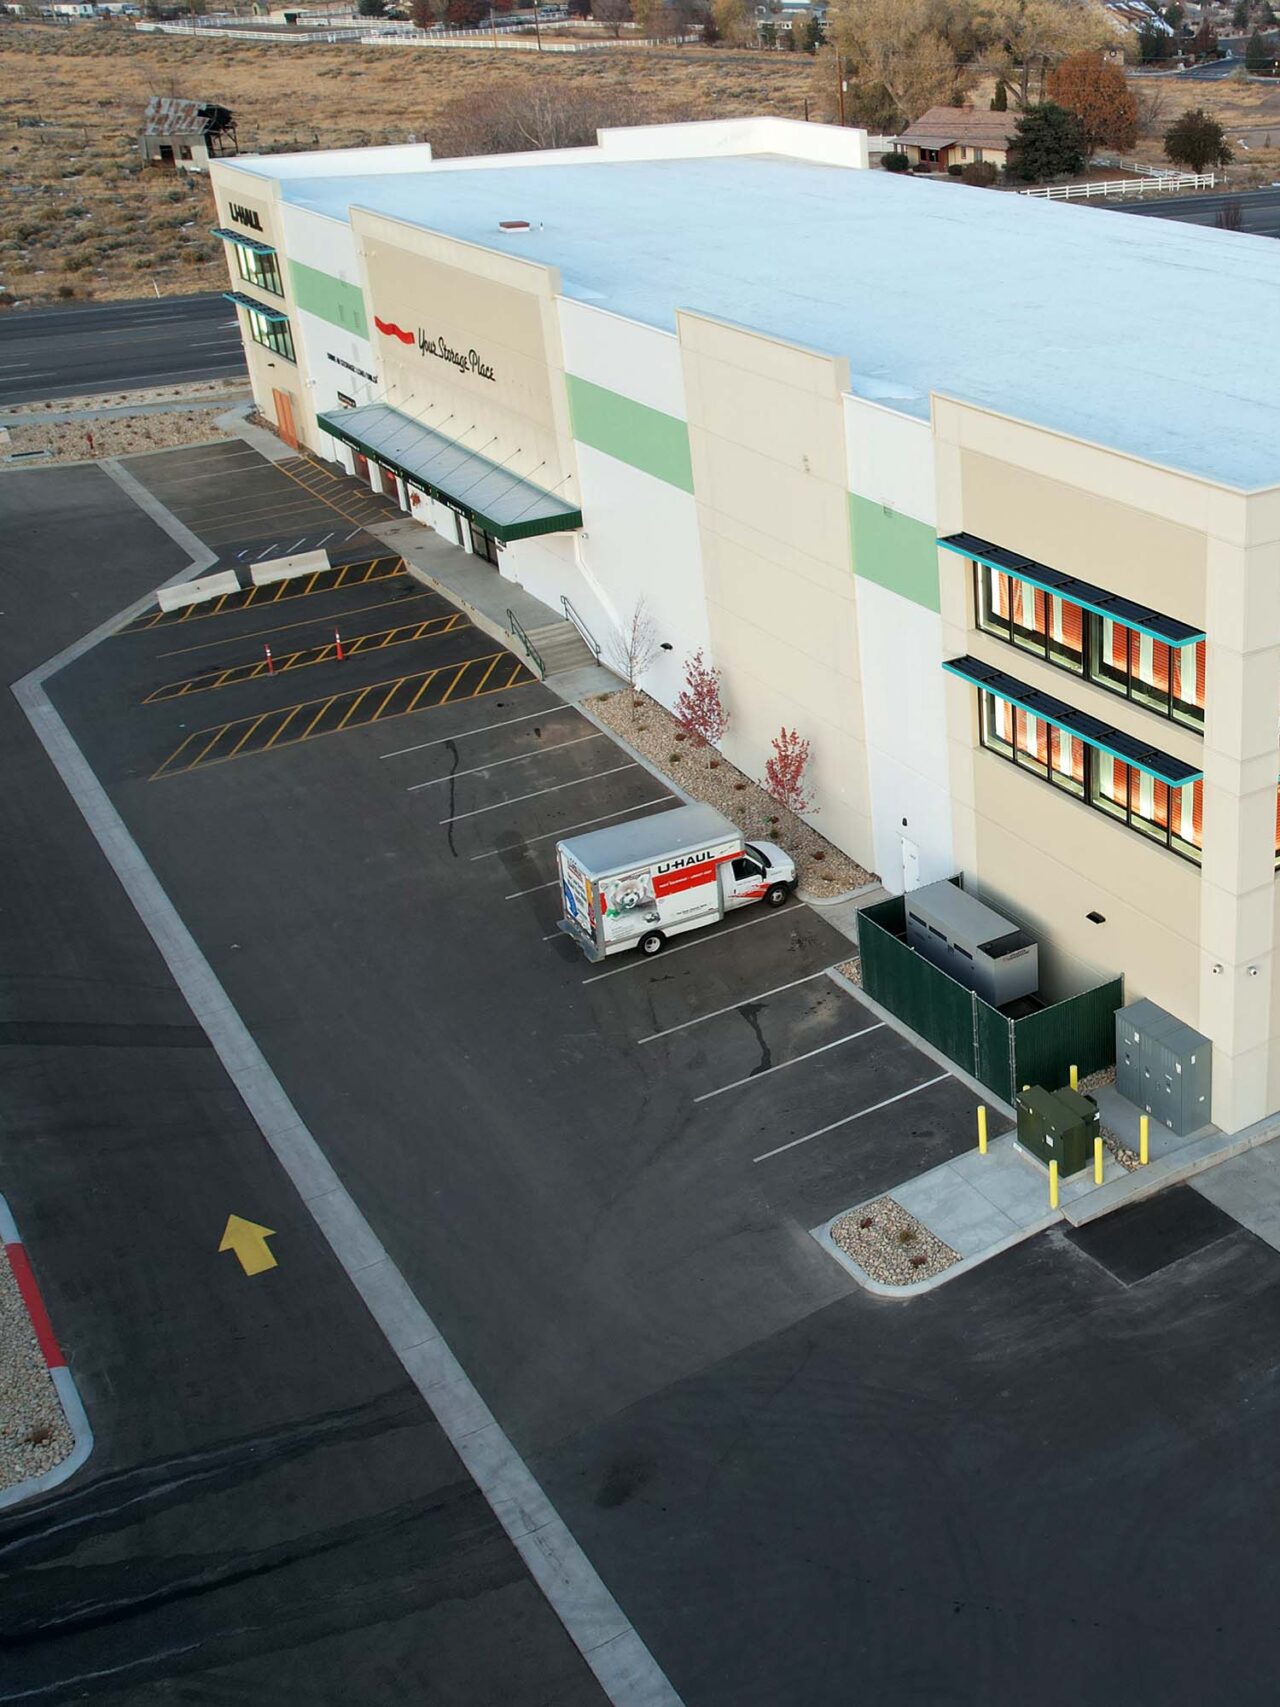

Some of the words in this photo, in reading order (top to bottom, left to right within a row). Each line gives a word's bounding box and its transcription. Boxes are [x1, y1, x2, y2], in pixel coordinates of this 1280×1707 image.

[418, 328, 438, 357] Your
[437, 336, 470, 373] Storage
[468, 349, 496, 382] Place
[657, 850, 715, 874] U-HAUL
